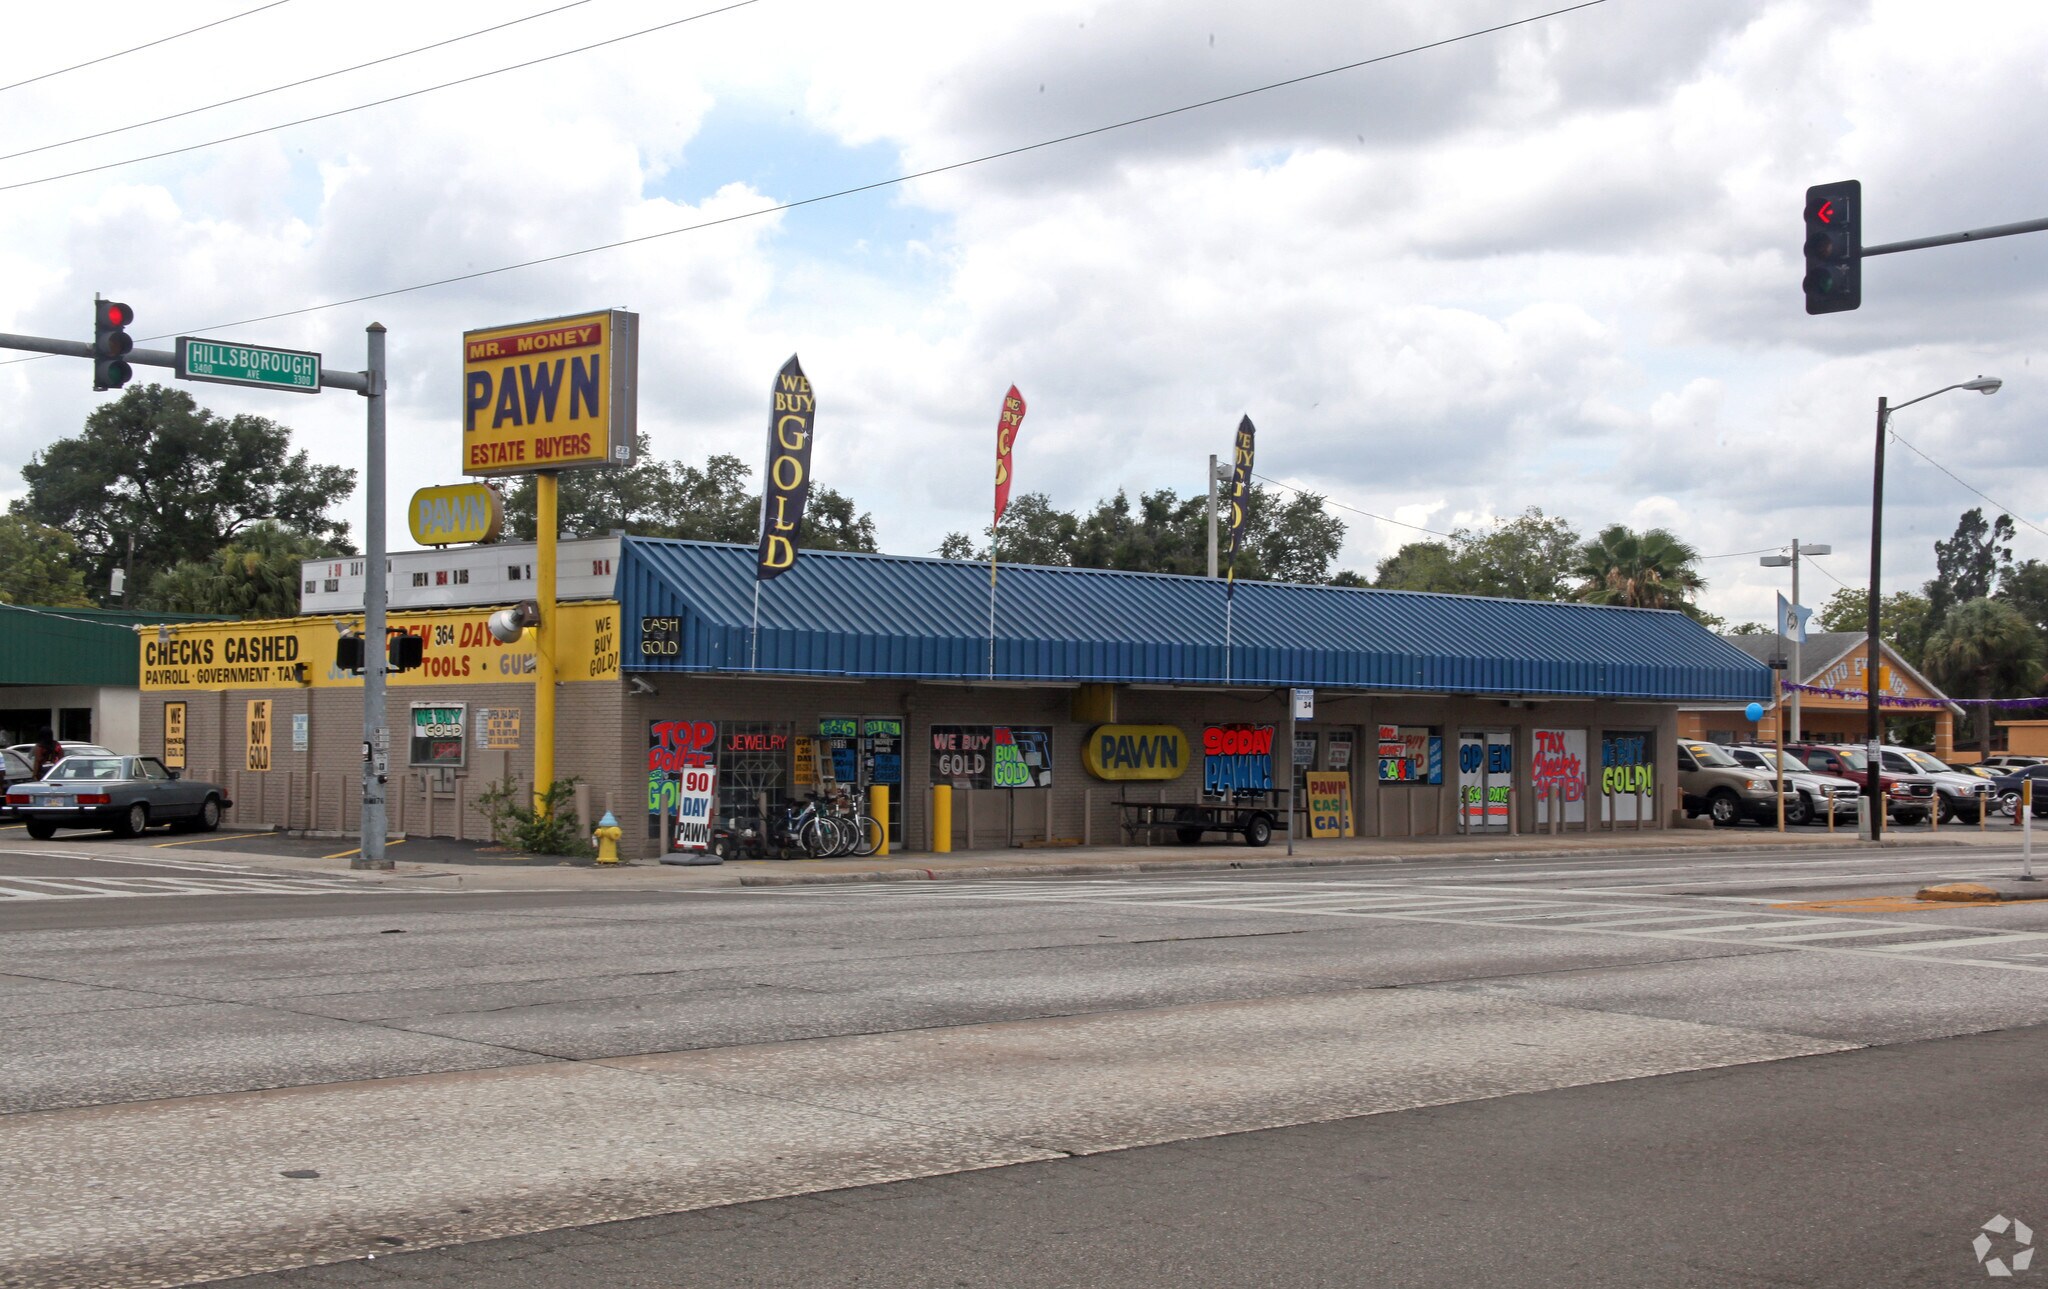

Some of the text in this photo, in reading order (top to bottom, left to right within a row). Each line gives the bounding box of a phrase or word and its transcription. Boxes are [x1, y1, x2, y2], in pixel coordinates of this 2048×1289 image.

[470, 328, 592, 359] MR. MONEY
[193, 344, 312, 375] HILLSBOROUGH
[194, 363, 310, 385] 3400 AVE 3300
[780, 374, 811, 392] WE
[466, 354, 600, 432] PAWN
[775, 391, 816, 412] BUY
[471, 440, 525, 465] ESTATE
[535, 432, 591, 459] BUYERS
[419, 494, 486, 535] PAWN
[595, 616, 611, 634] WE
[641, 618, 679, 632] CASH
[435, 625, 454, 647] 364
[594, 633, 612, 656] BUY
[146, 635, 299, 666] CHECKS CASHED
[641, 640, 678, 654] GOLD
[422, 655, 470, 677] TOOLS
[590, 651, 618, 677] GOLD!
[145, 668, 190, 685] PAYROLL
[197, 666, 269, 684] GOVERNMENT
[170, 708, 181, 724] WE
[254, 701, 266, 719] WE
[416, 709, 462, 726] WE BUY
[251, 720, 266, 744] BUY
[425, 723, 462, 737] GOLD
[652, 720, 716, 751] TOP
[994, 727, 1012, 745] WE
[167, 748, 184, 756] GOLD
[727, 735, 787, 751] JEWELRY
[933, 734, 991, 750] WE BUY
[1101, 735, 1178, 769] PAWN
[1535, 731, 1566, 754] TAX
[249, 746, 268, 769] GOLD
[995, 744, 1018, 762] BUY
[939, 754, 985, 775] GOLD
[994, 762, 1029, 785] GOLD
[1204, 754, 1274, 794] PAWN!
[686, 772, 709, 793] 90
[1311, 781, 1347, 795] PAWN
[1602, 762, 1653, 797] GOLD!
[1488, 786, 1510, 803] DAYS
[682, 797, 709, 817] DAY
[679, 822, 709, 843] PAWN
